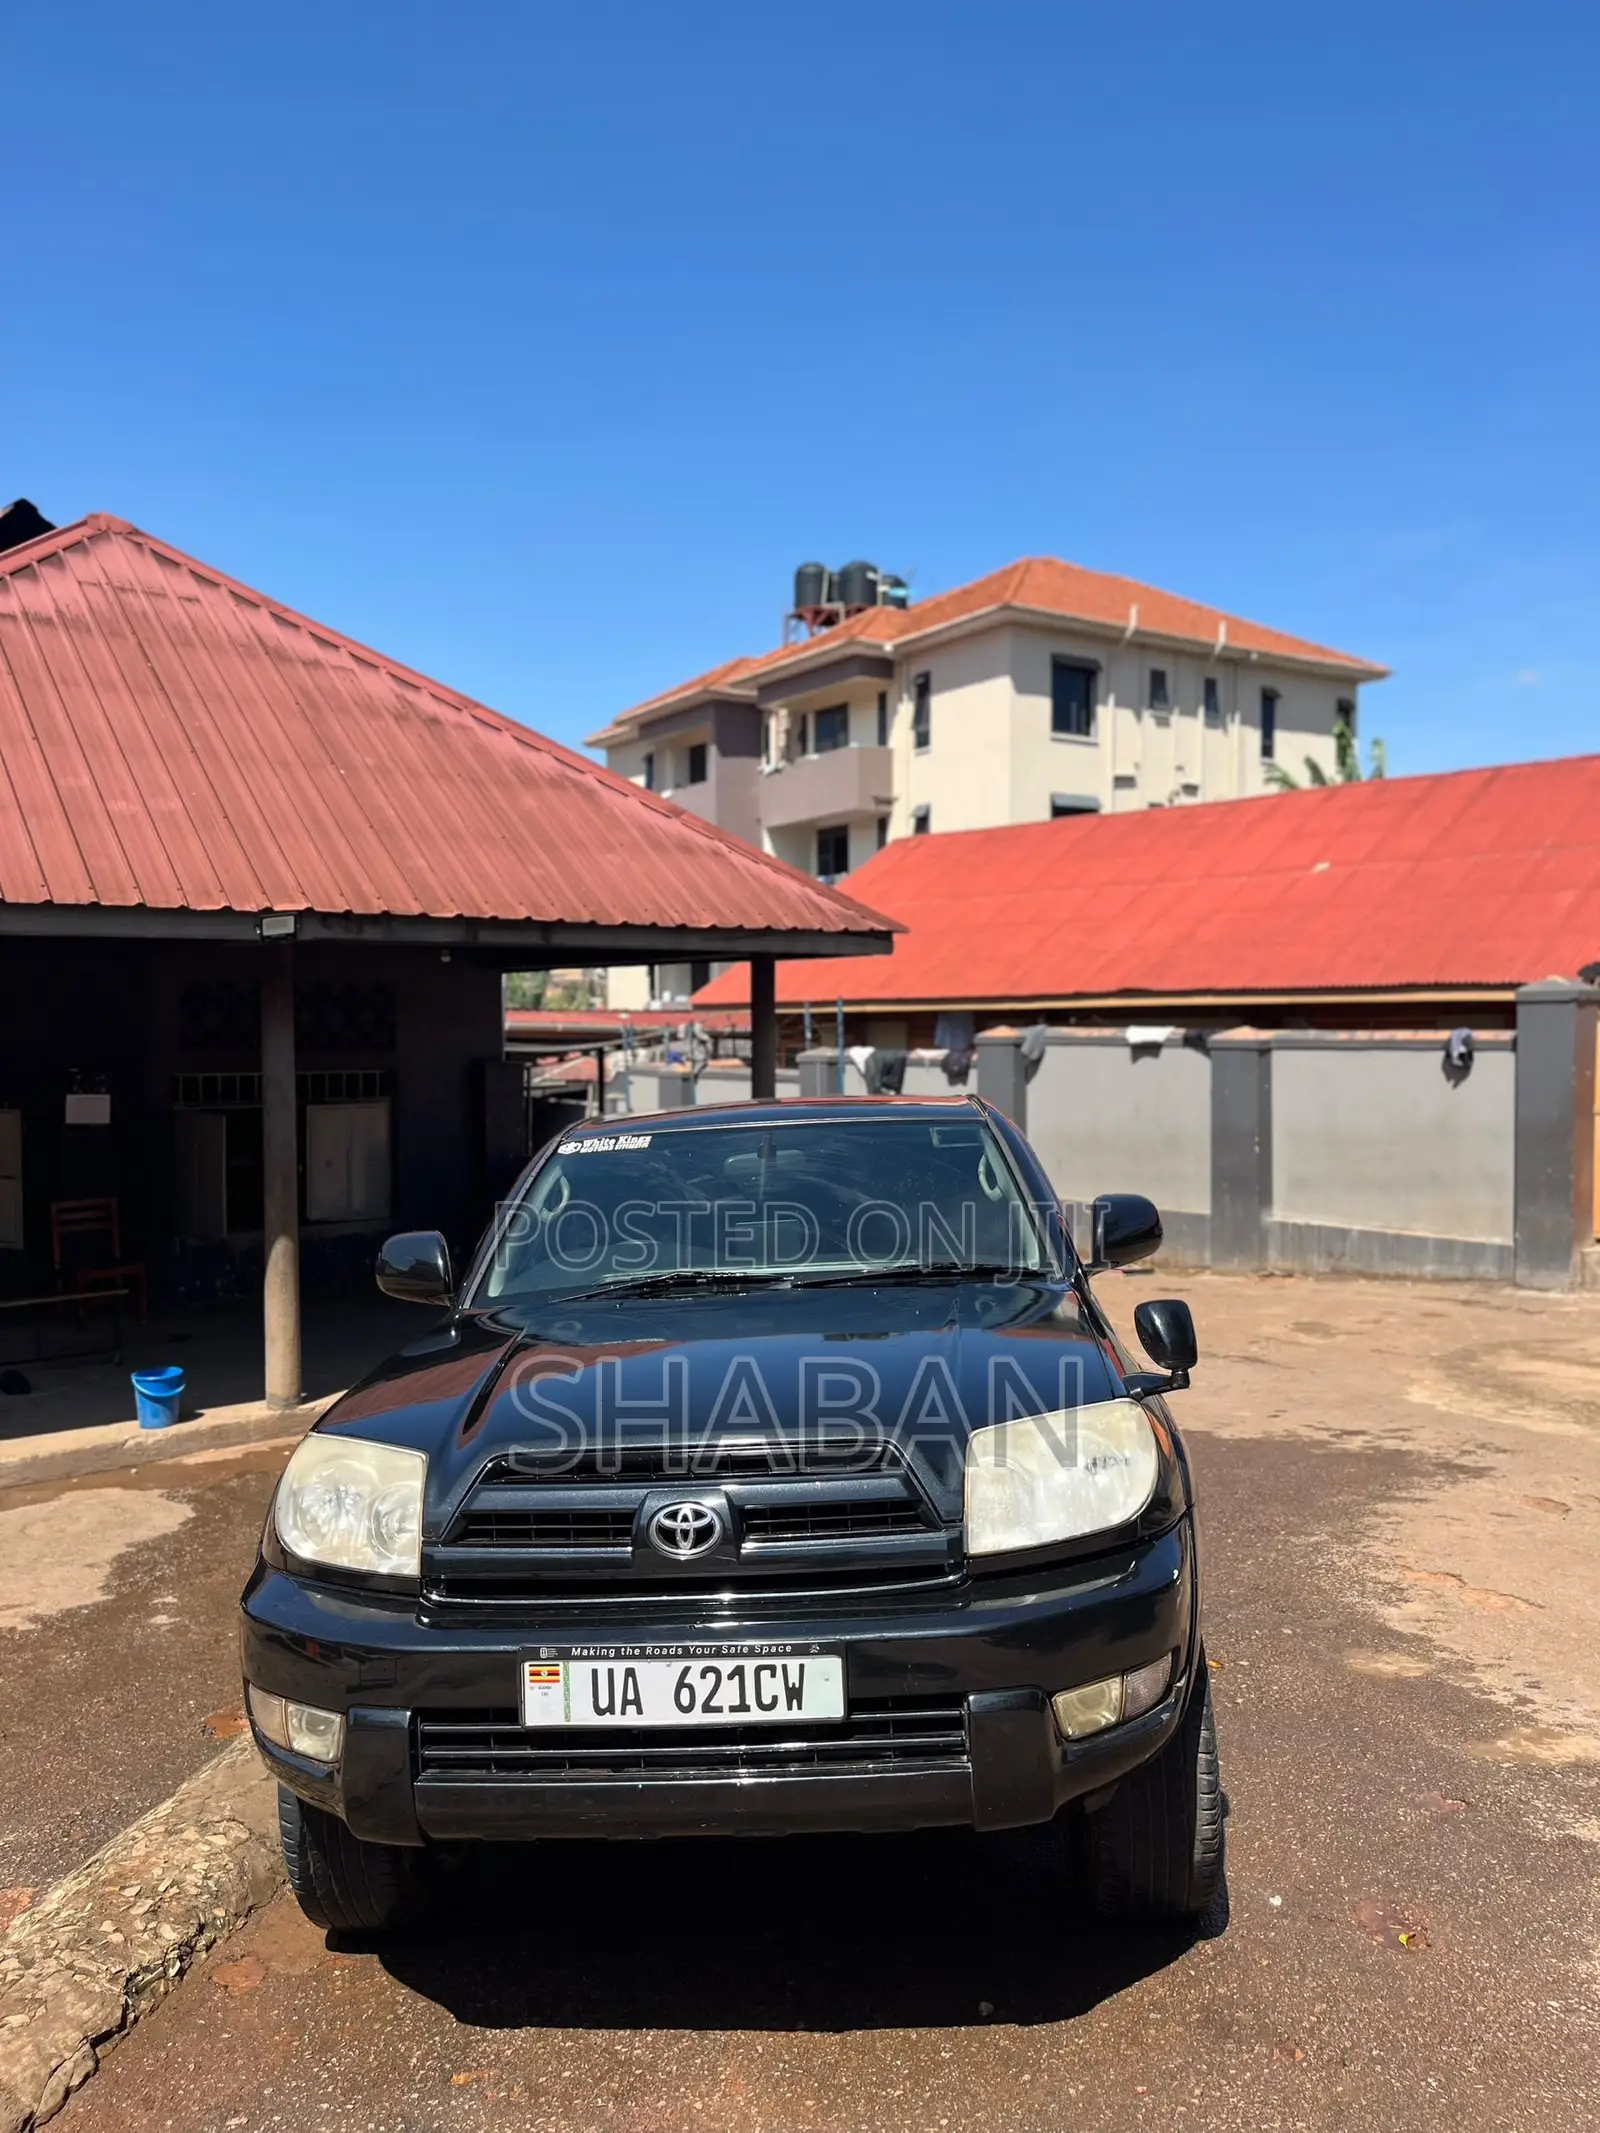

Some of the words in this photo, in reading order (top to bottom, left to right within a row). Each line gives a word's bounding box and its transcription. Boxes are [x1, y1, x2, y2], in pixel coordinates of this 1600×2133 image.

[583, 1137, 616, 1148] White
[571, 1646, 616, 1657] Making
[621, 1646, 641, 1656] the
[645, 1646, 684, 1656] Roads
[688, 1645, 717, 1655] Your
[721, 1645, 749, 1654] Safe
[754, 1644, 792, 1655] Space
[591, 1666, 644, 1716] UA
[673, 1663, 806, 1714] 621CW
